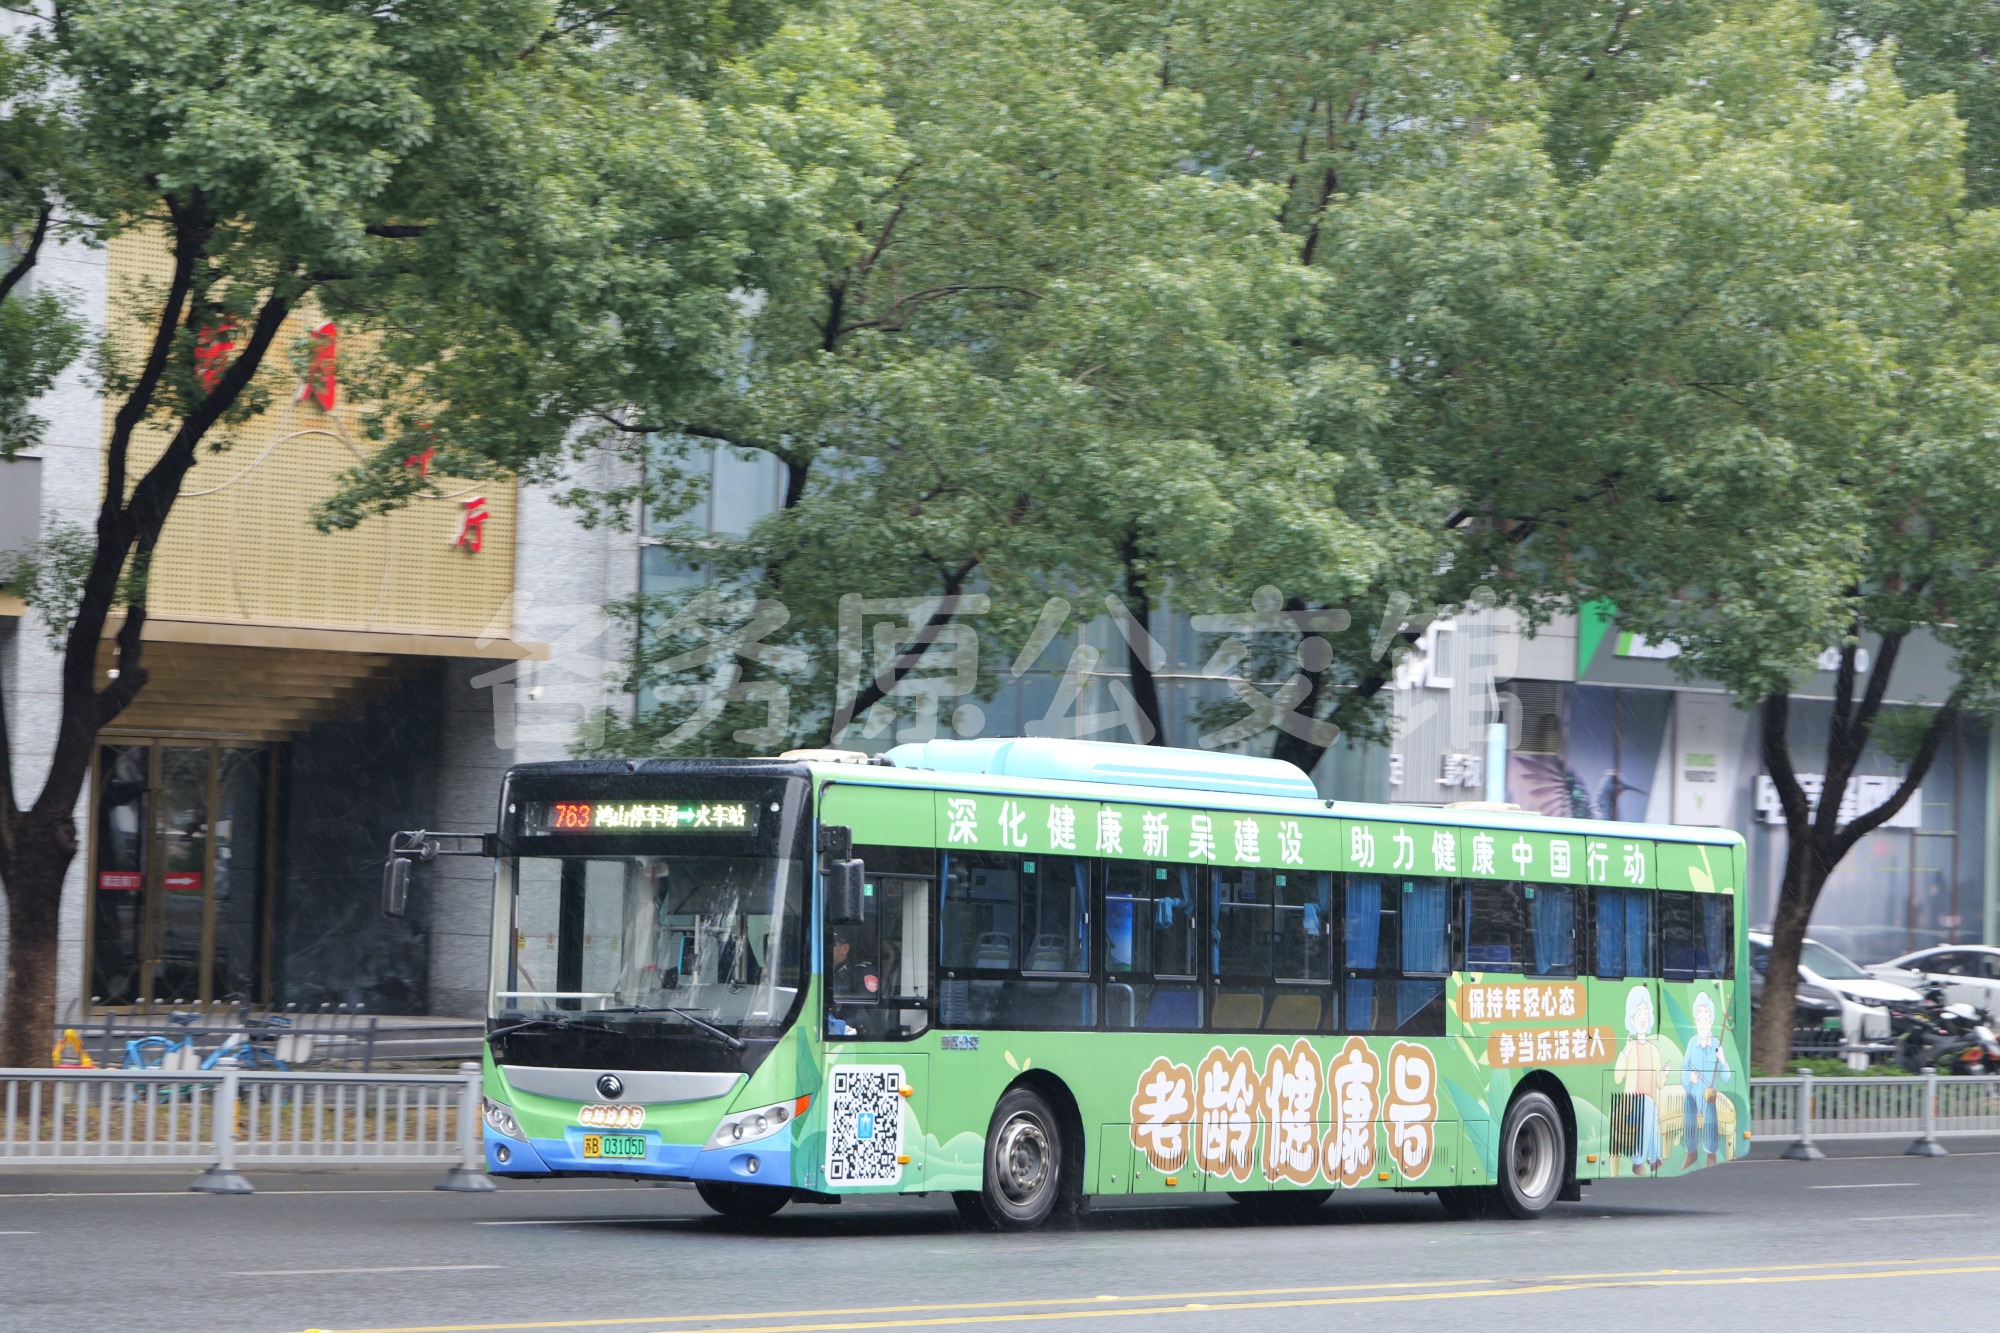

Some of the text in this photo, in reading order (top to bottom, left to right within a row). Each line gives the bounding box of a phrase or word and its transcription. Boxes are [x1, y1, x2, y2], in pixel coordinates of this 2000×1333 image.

[556, 805, 590, 827] 763
[694, 804, 746, 827] 火车站
[947, 797, 1304, 866] 深化健康新吴建设
[1350, 825, 1646, 885] 助力健康中国行动
[1467, 985, 1575, 1020] 保持年轻心态
[1499, 1027, 1606, 1065] 争当乐活老人
[1136, 1046, 1433, 1177] 老龄健康号
